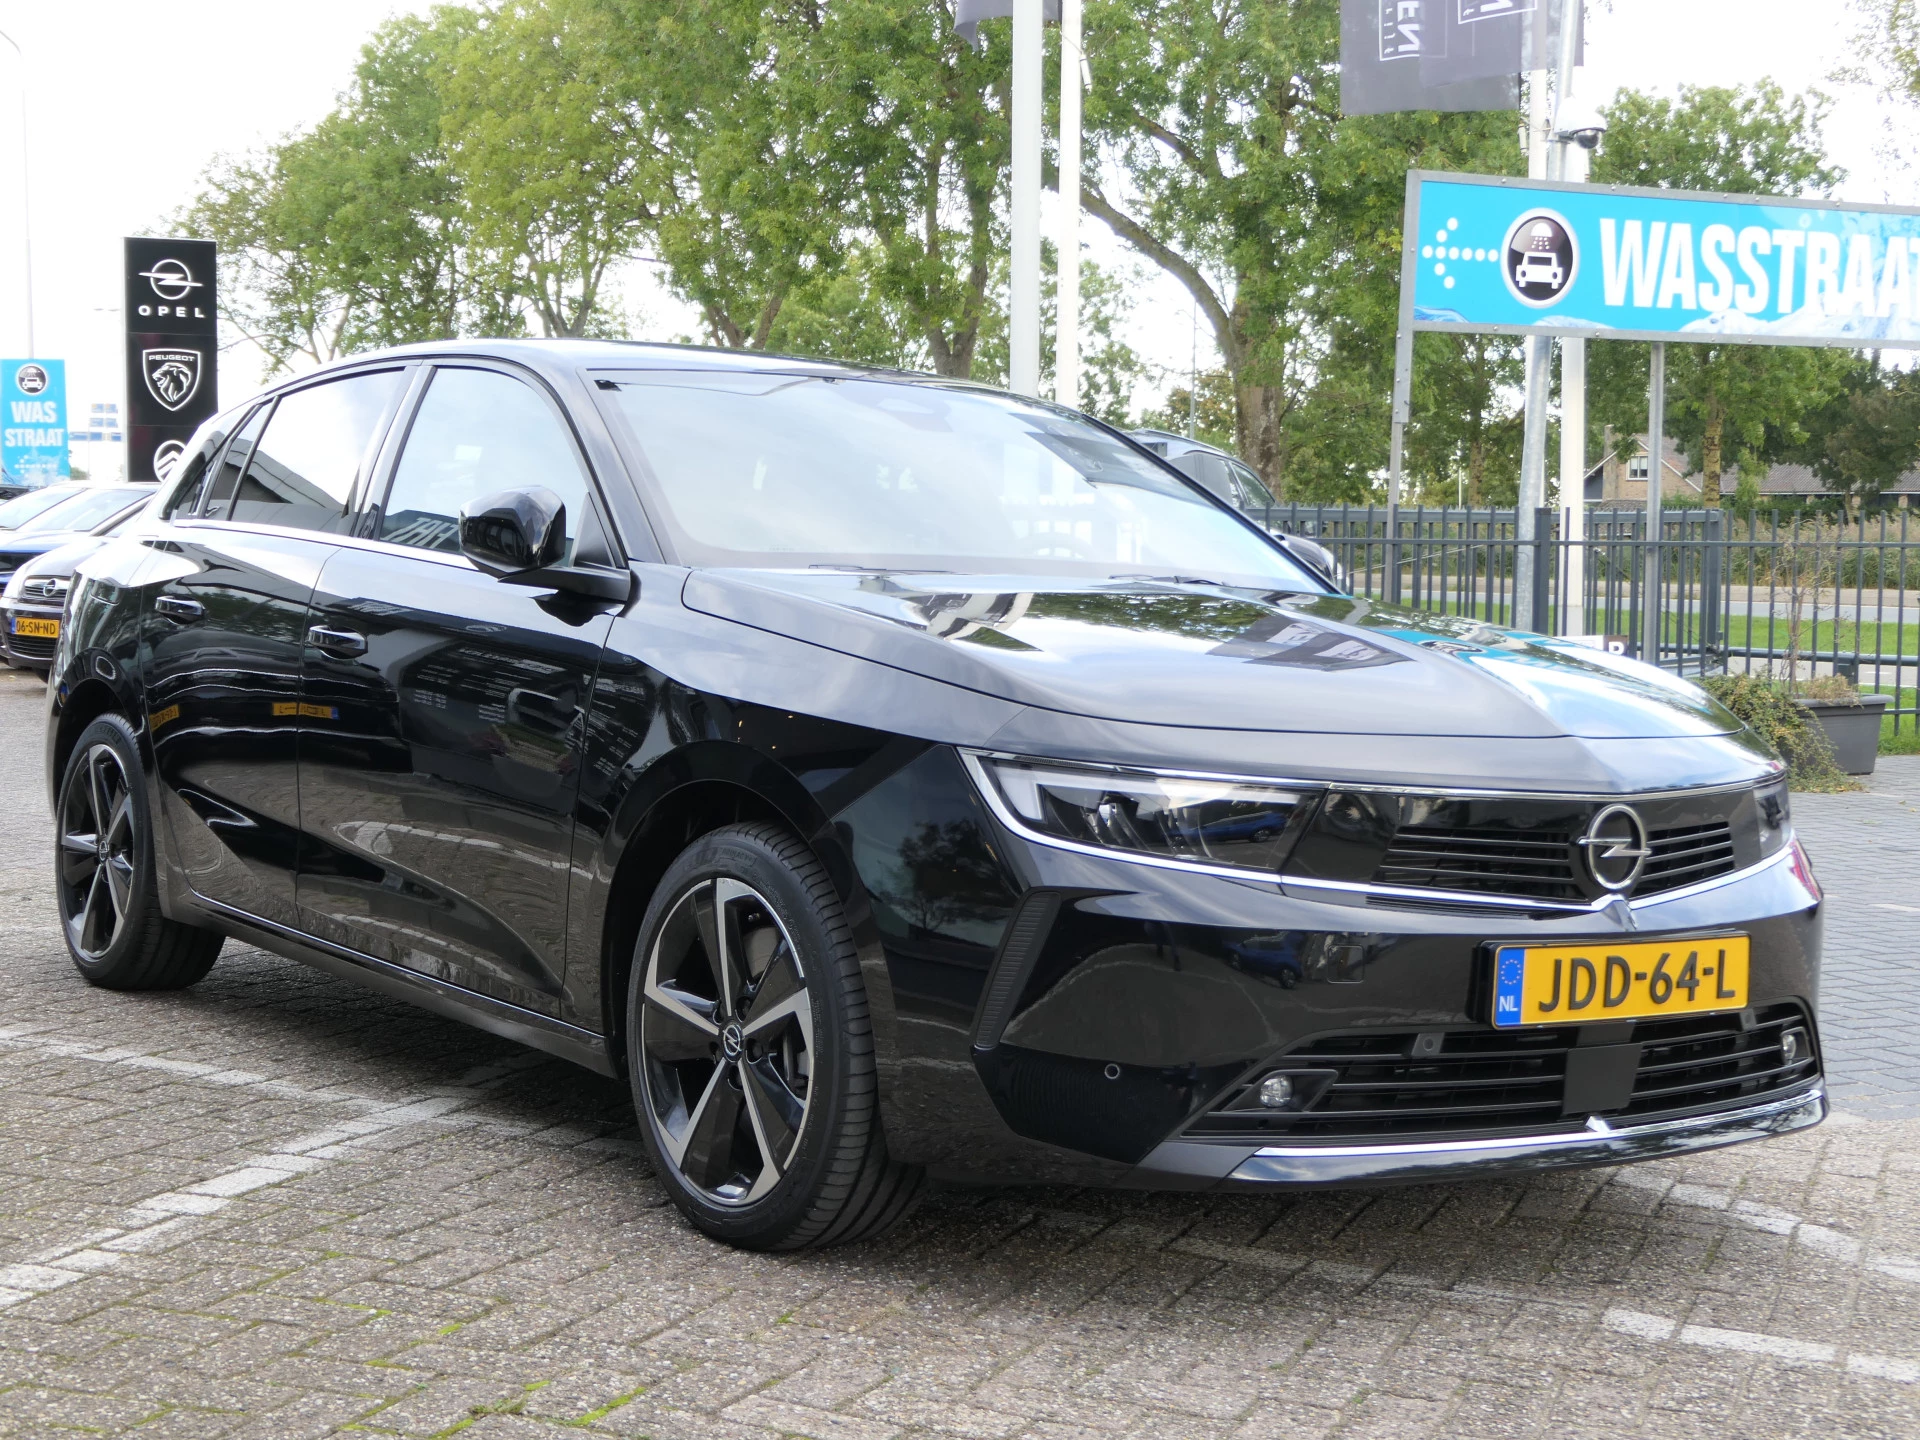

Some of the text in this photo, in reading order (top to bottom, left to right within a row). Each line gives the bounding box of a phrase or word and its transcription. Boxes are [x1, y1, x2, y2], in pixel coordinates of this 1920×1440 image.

[138, 304, 206, 319] OPEL
[148, 354, 196, 362] PEUGEOT
[10, 400, 58, 424] WAS
[4, 427, 65, 448] STRAAT
[15, 619, 57, 636] 06-SN-ND
[1537, 948, 1737, 1013] JDD-64-L
[1498, 995, 1519, 1012] NL
